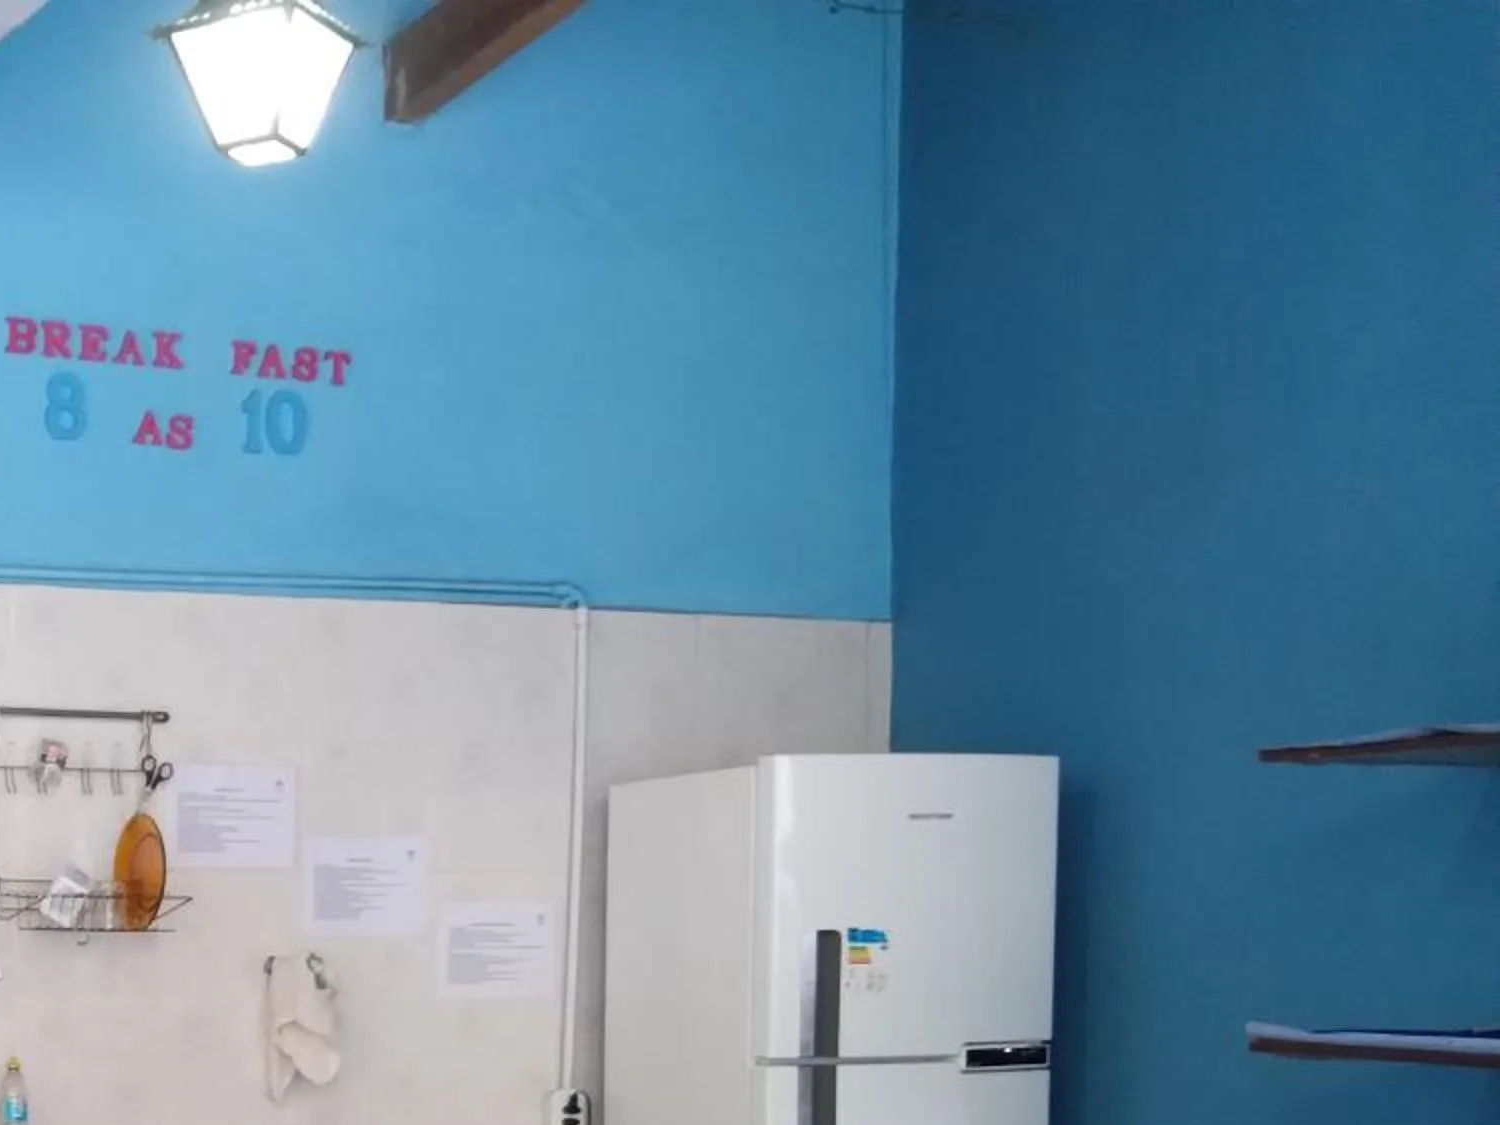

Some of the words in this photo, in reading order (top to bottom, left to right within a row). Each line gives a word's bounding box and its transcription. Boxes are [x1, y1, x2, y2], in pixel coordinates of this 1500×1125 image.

[5, 316, 185, 370] BREAK
[230, 339, 351, 387] FAST
[44, 371, 87, 441] 8
[132, 409, 195, 451] AS
[239, 388, 309, 456] 10
